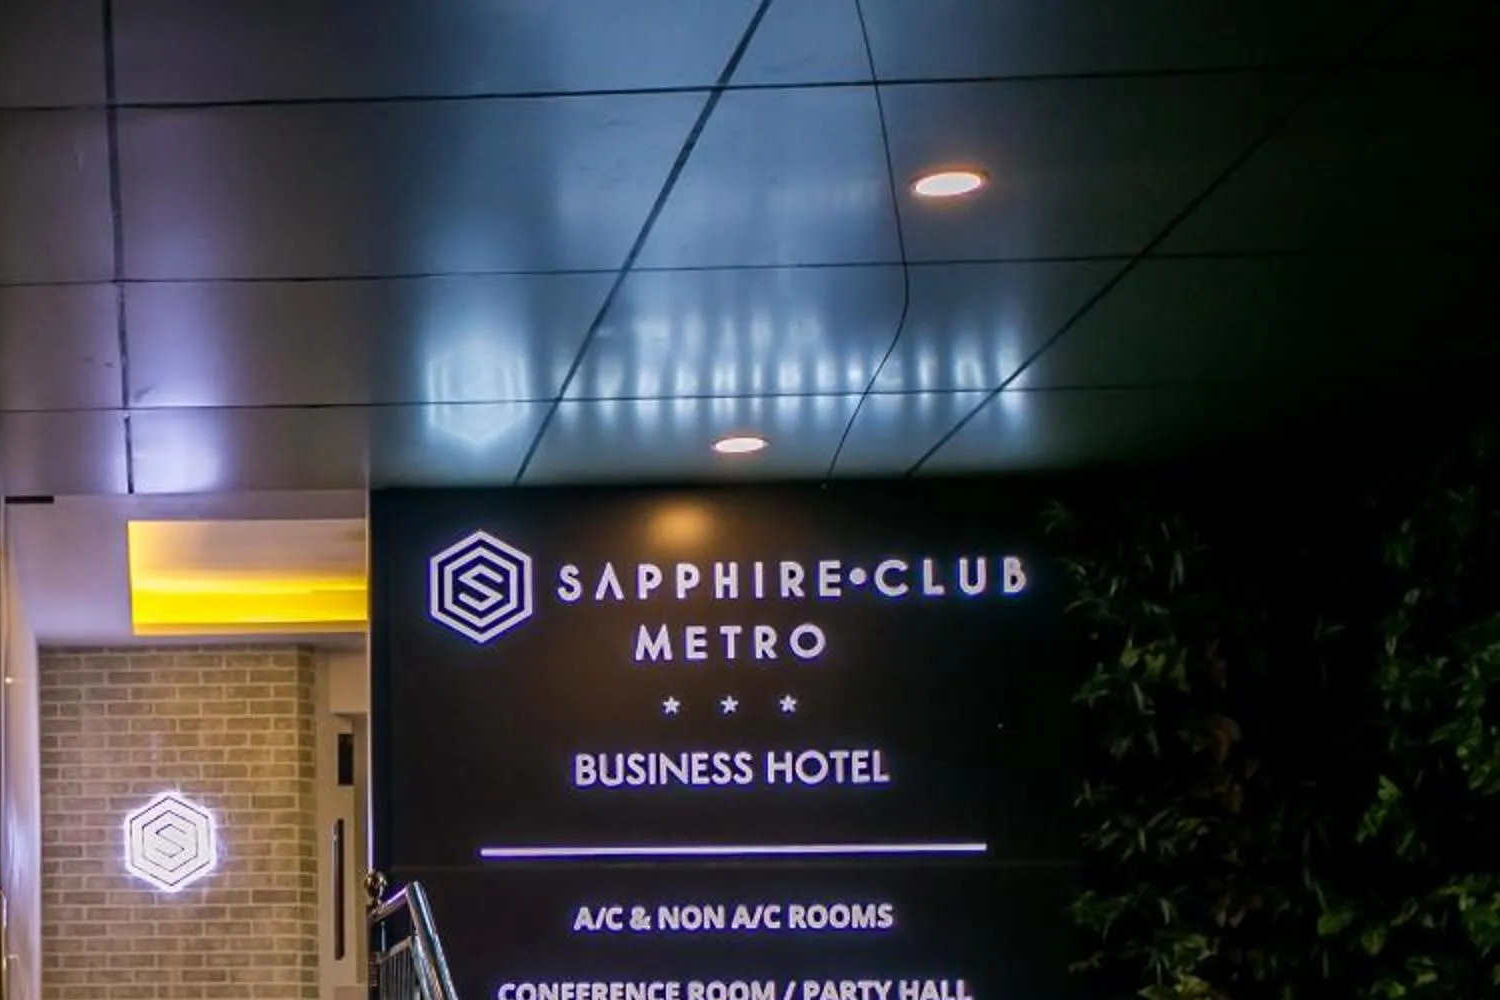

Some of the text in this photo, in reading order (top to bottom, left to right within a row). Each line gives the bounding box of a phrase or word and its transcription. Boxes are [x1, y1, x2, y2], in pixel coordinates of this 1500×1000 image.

[635, 623, 826, 661] METRO
[575, 749, 890, 787] BUSINESS HOTEL
[573, 903, 894, 931] A/C & NON A/C ROOMS
